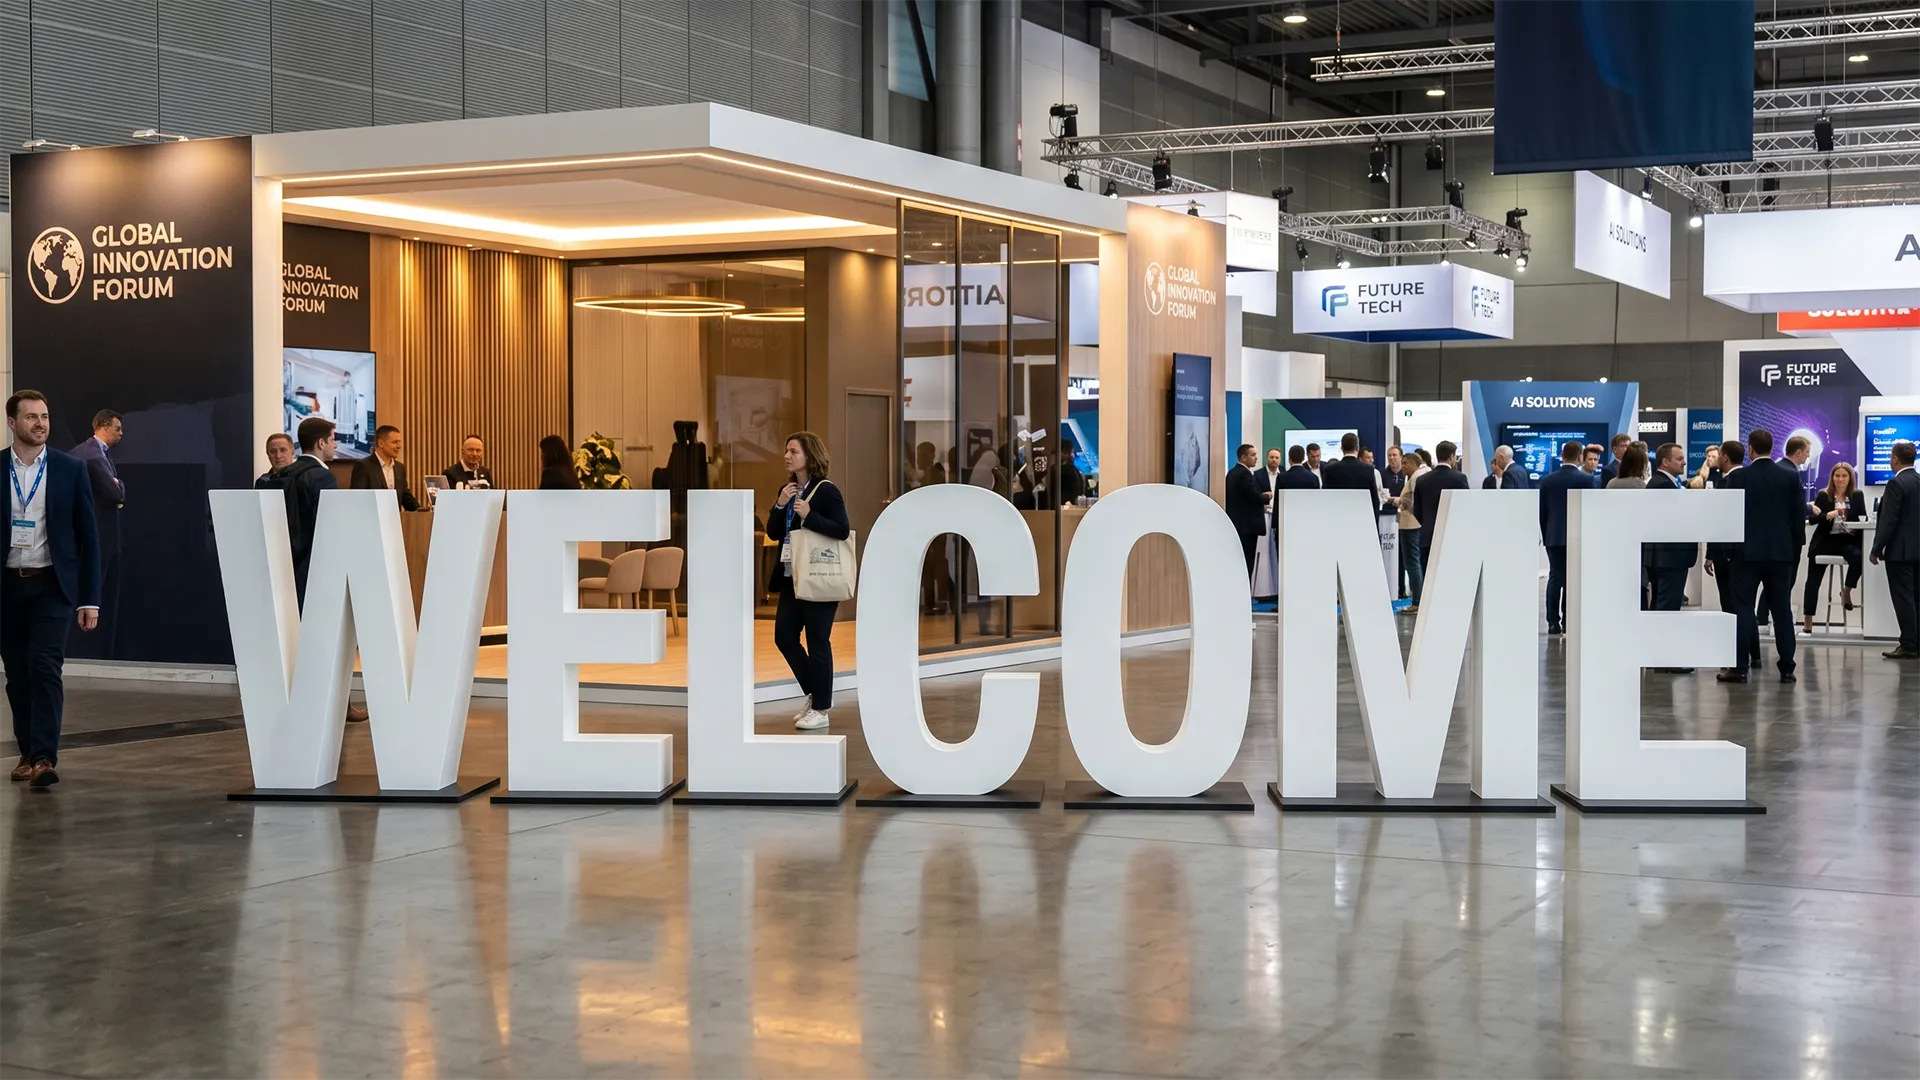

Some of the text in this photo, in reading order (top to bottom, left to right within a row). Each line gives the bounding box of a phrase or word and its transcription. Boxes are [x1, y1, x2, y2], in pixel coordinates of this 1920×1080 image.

[92, 221, 183, 248] GLOBAL
[1616, 224, 1646, 252] SOLUTIONS
[93, 246, 233, 275] INNOVATION
[1167, 264, 1200, 286] GLOBAL
[93, 276, 174, 301] FORUM
[282, 279, 359, 301] NNOVATION
[1167, 282, 1217, 306] INNOVATION
[1358, 281, 1425, 298] FUTURE
[283, 296, 326, 314] ORUM
[1167, 301, 1197, 320] FORUM
[1358, 300, 1402, 315] TECH
[1786, 362, 1837, 375] FUTURE
[1786, 375, 1820, 386] TECH
[1510, 396, 1596, 409] AI SOLUTIONS
[208, 483, 1746, 800] WELCOME
